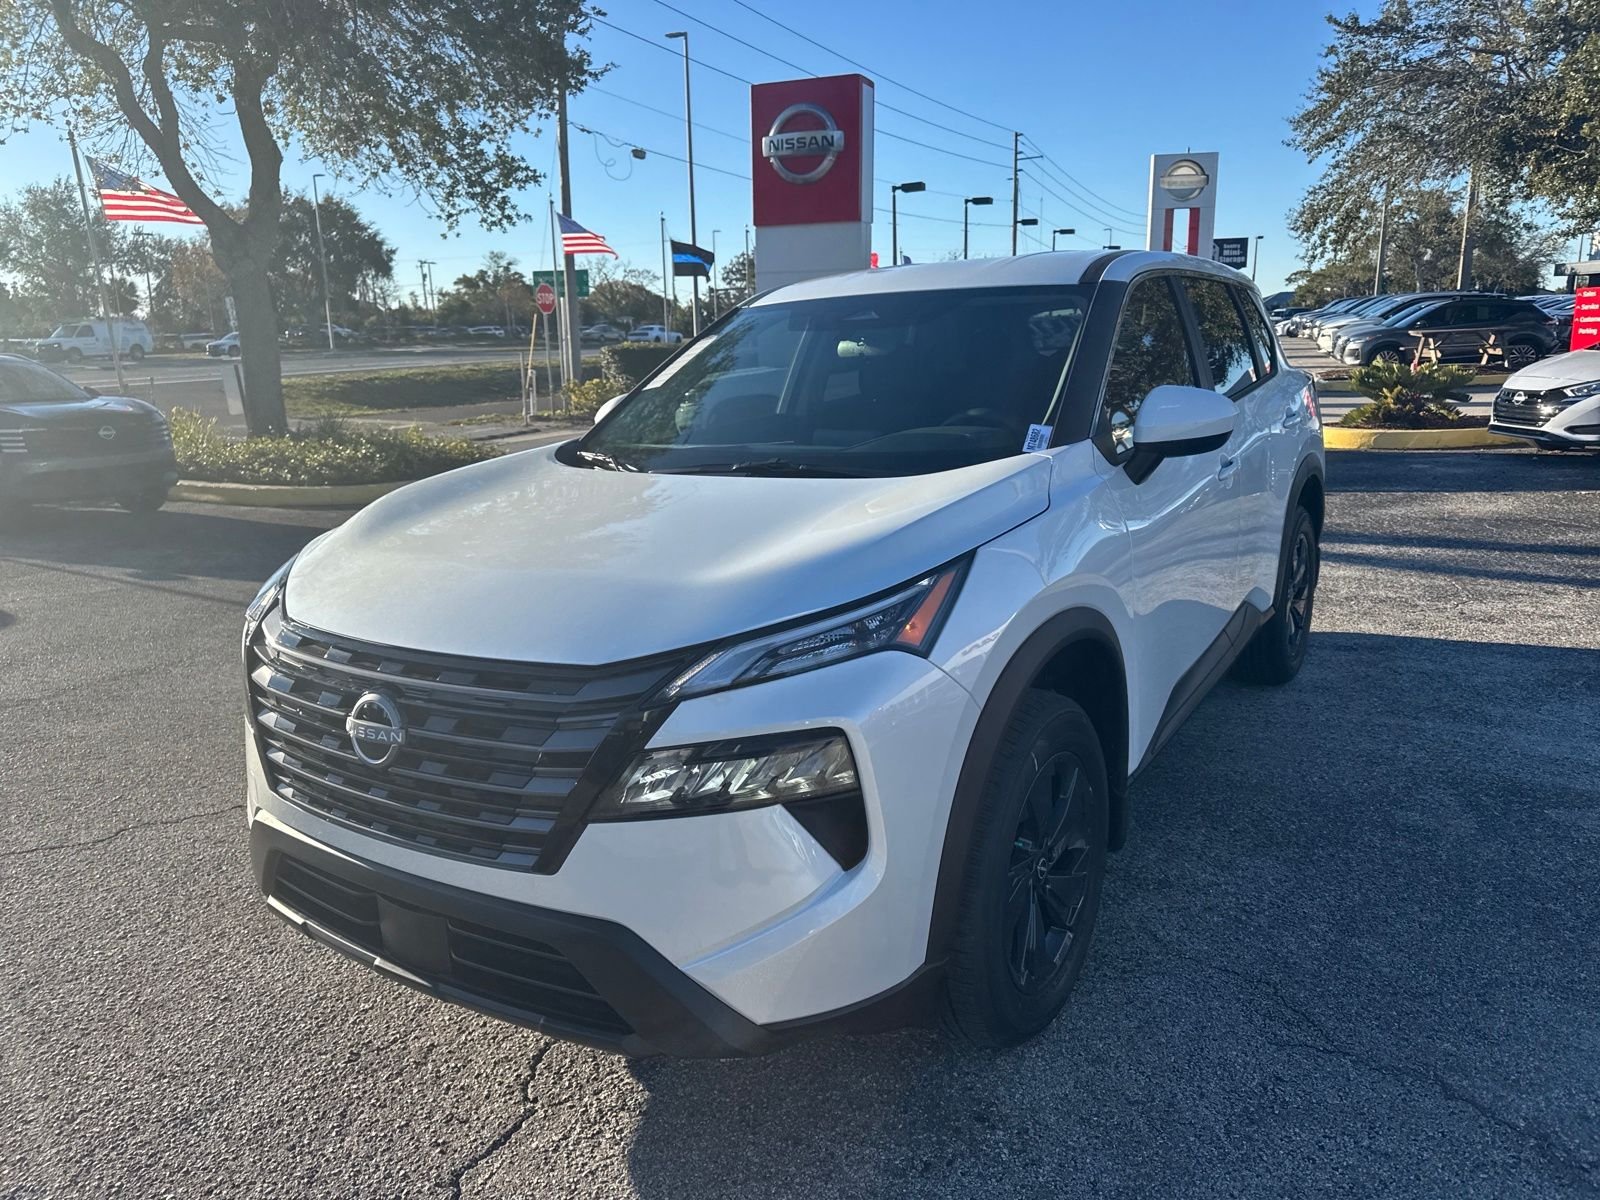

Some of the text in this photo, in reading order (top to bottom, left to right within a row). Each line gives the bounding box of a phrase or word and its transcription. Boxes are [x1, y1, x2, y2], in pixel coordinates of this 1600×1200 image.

[768, 135, 834, 152] NISSAN
[537, 293, 553, 304] STOP
[1578, 327, 1598, 335] Parking
